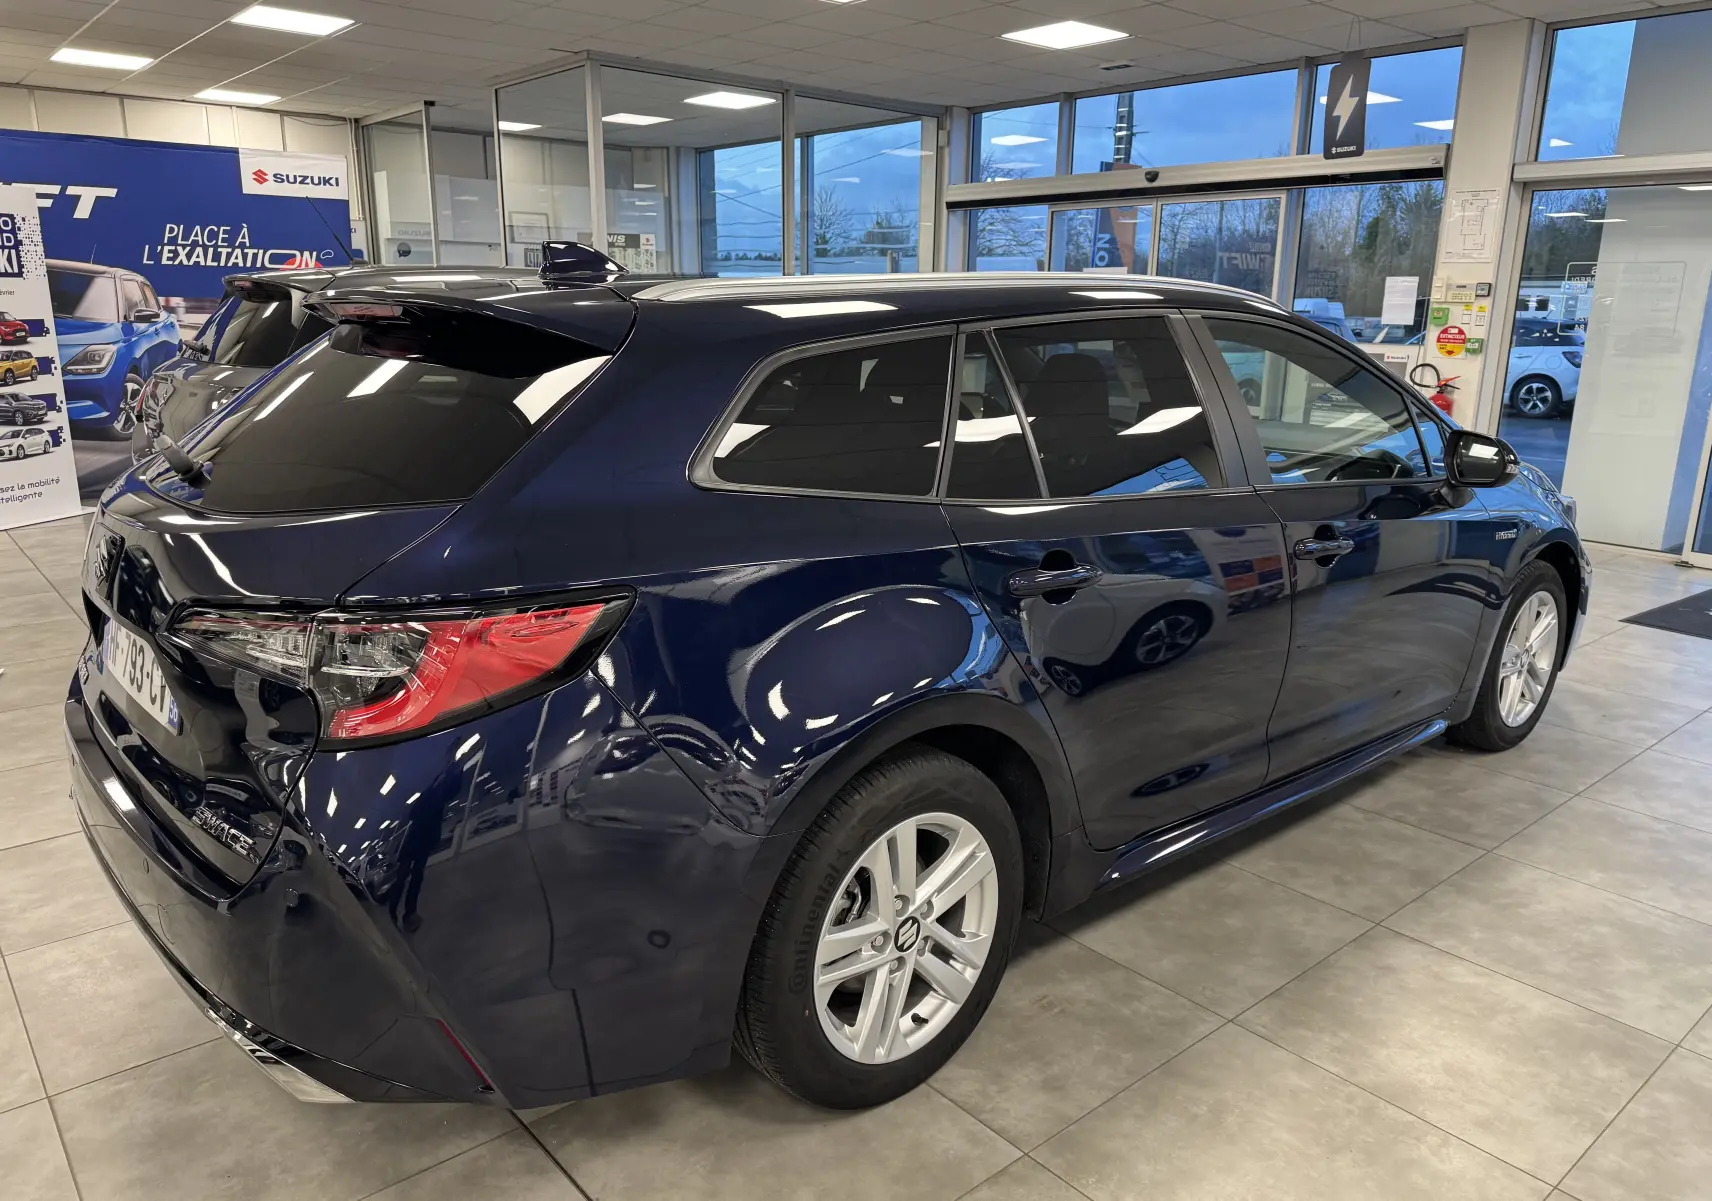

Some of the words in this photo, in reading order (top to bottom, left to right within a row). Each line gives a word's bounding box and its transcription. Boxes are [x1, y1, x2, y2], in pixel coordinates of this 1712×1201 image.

[1336, 145, 1357, 153] SUZUKI
[272, 172, 340, 187] SUZUKI
[164, 223, 231, 246] PLACE
[235, 223, 250, 247] À
[142, 245, 317, 269] L'EXALTATION
[17, 482, 26, 491] la
[28, 476, 60, 489] mobilité
[0, 491, 43, 504] telligente
